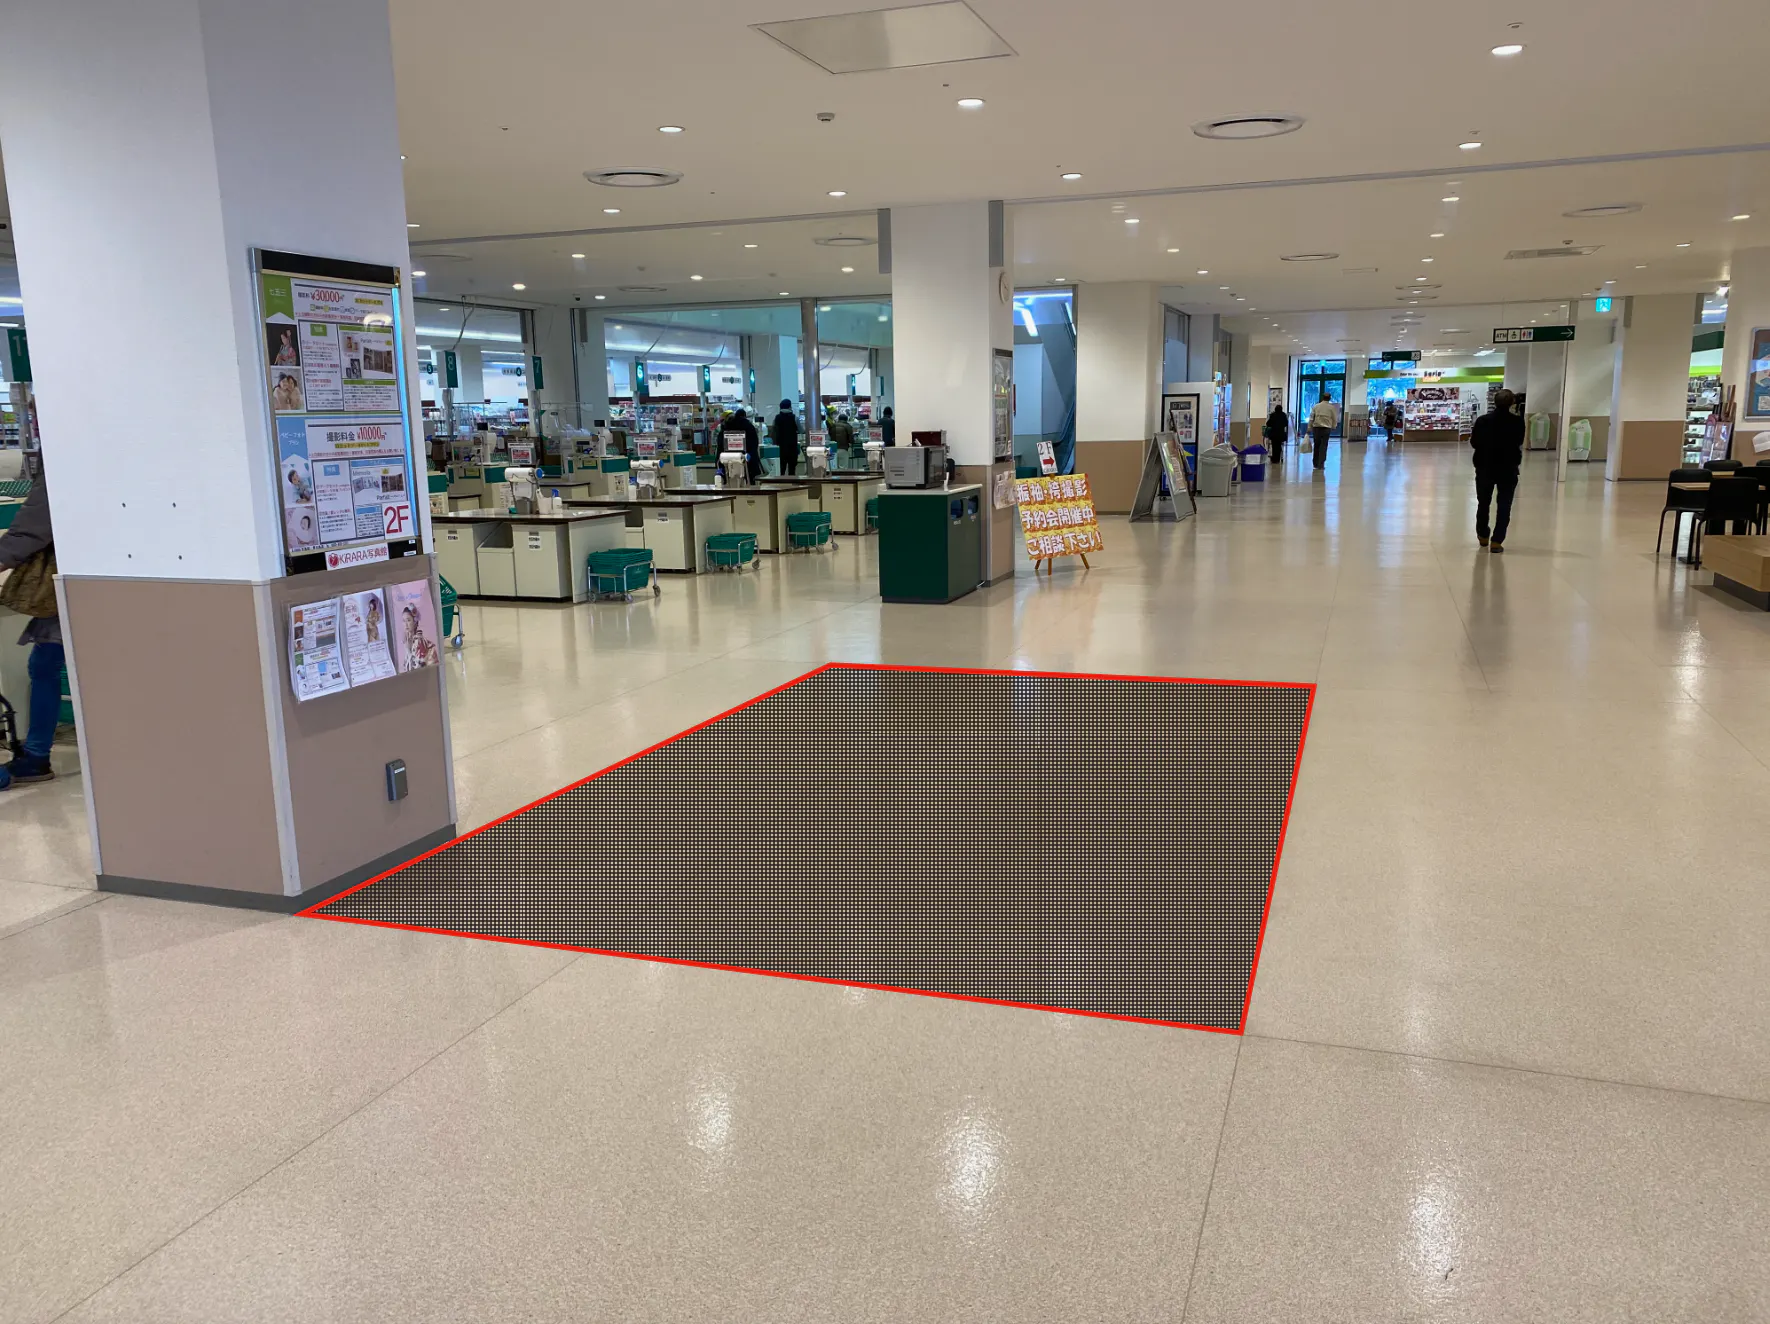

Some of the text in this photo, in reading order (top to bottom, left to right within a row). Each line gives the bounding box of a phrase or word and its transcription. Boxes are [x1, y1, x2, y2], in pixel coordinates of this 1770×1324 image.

[12, 334, 27, 357] 1
[447, 355, 454, 371] 8
[534, 360, 540, 373] 7
[636, 365, 643, 379] 6
[704, 368, 709, 380] 5
[326, 431, 355, 442] 撮影料金
[1016, 479, 1087, 502] 振袖・袴撮影
[384, 504, 409, 534] 2F
[1021, 505, 1093, 529] 予約会開催中
[1027, 531, 1101, 555] ご相談下さい
